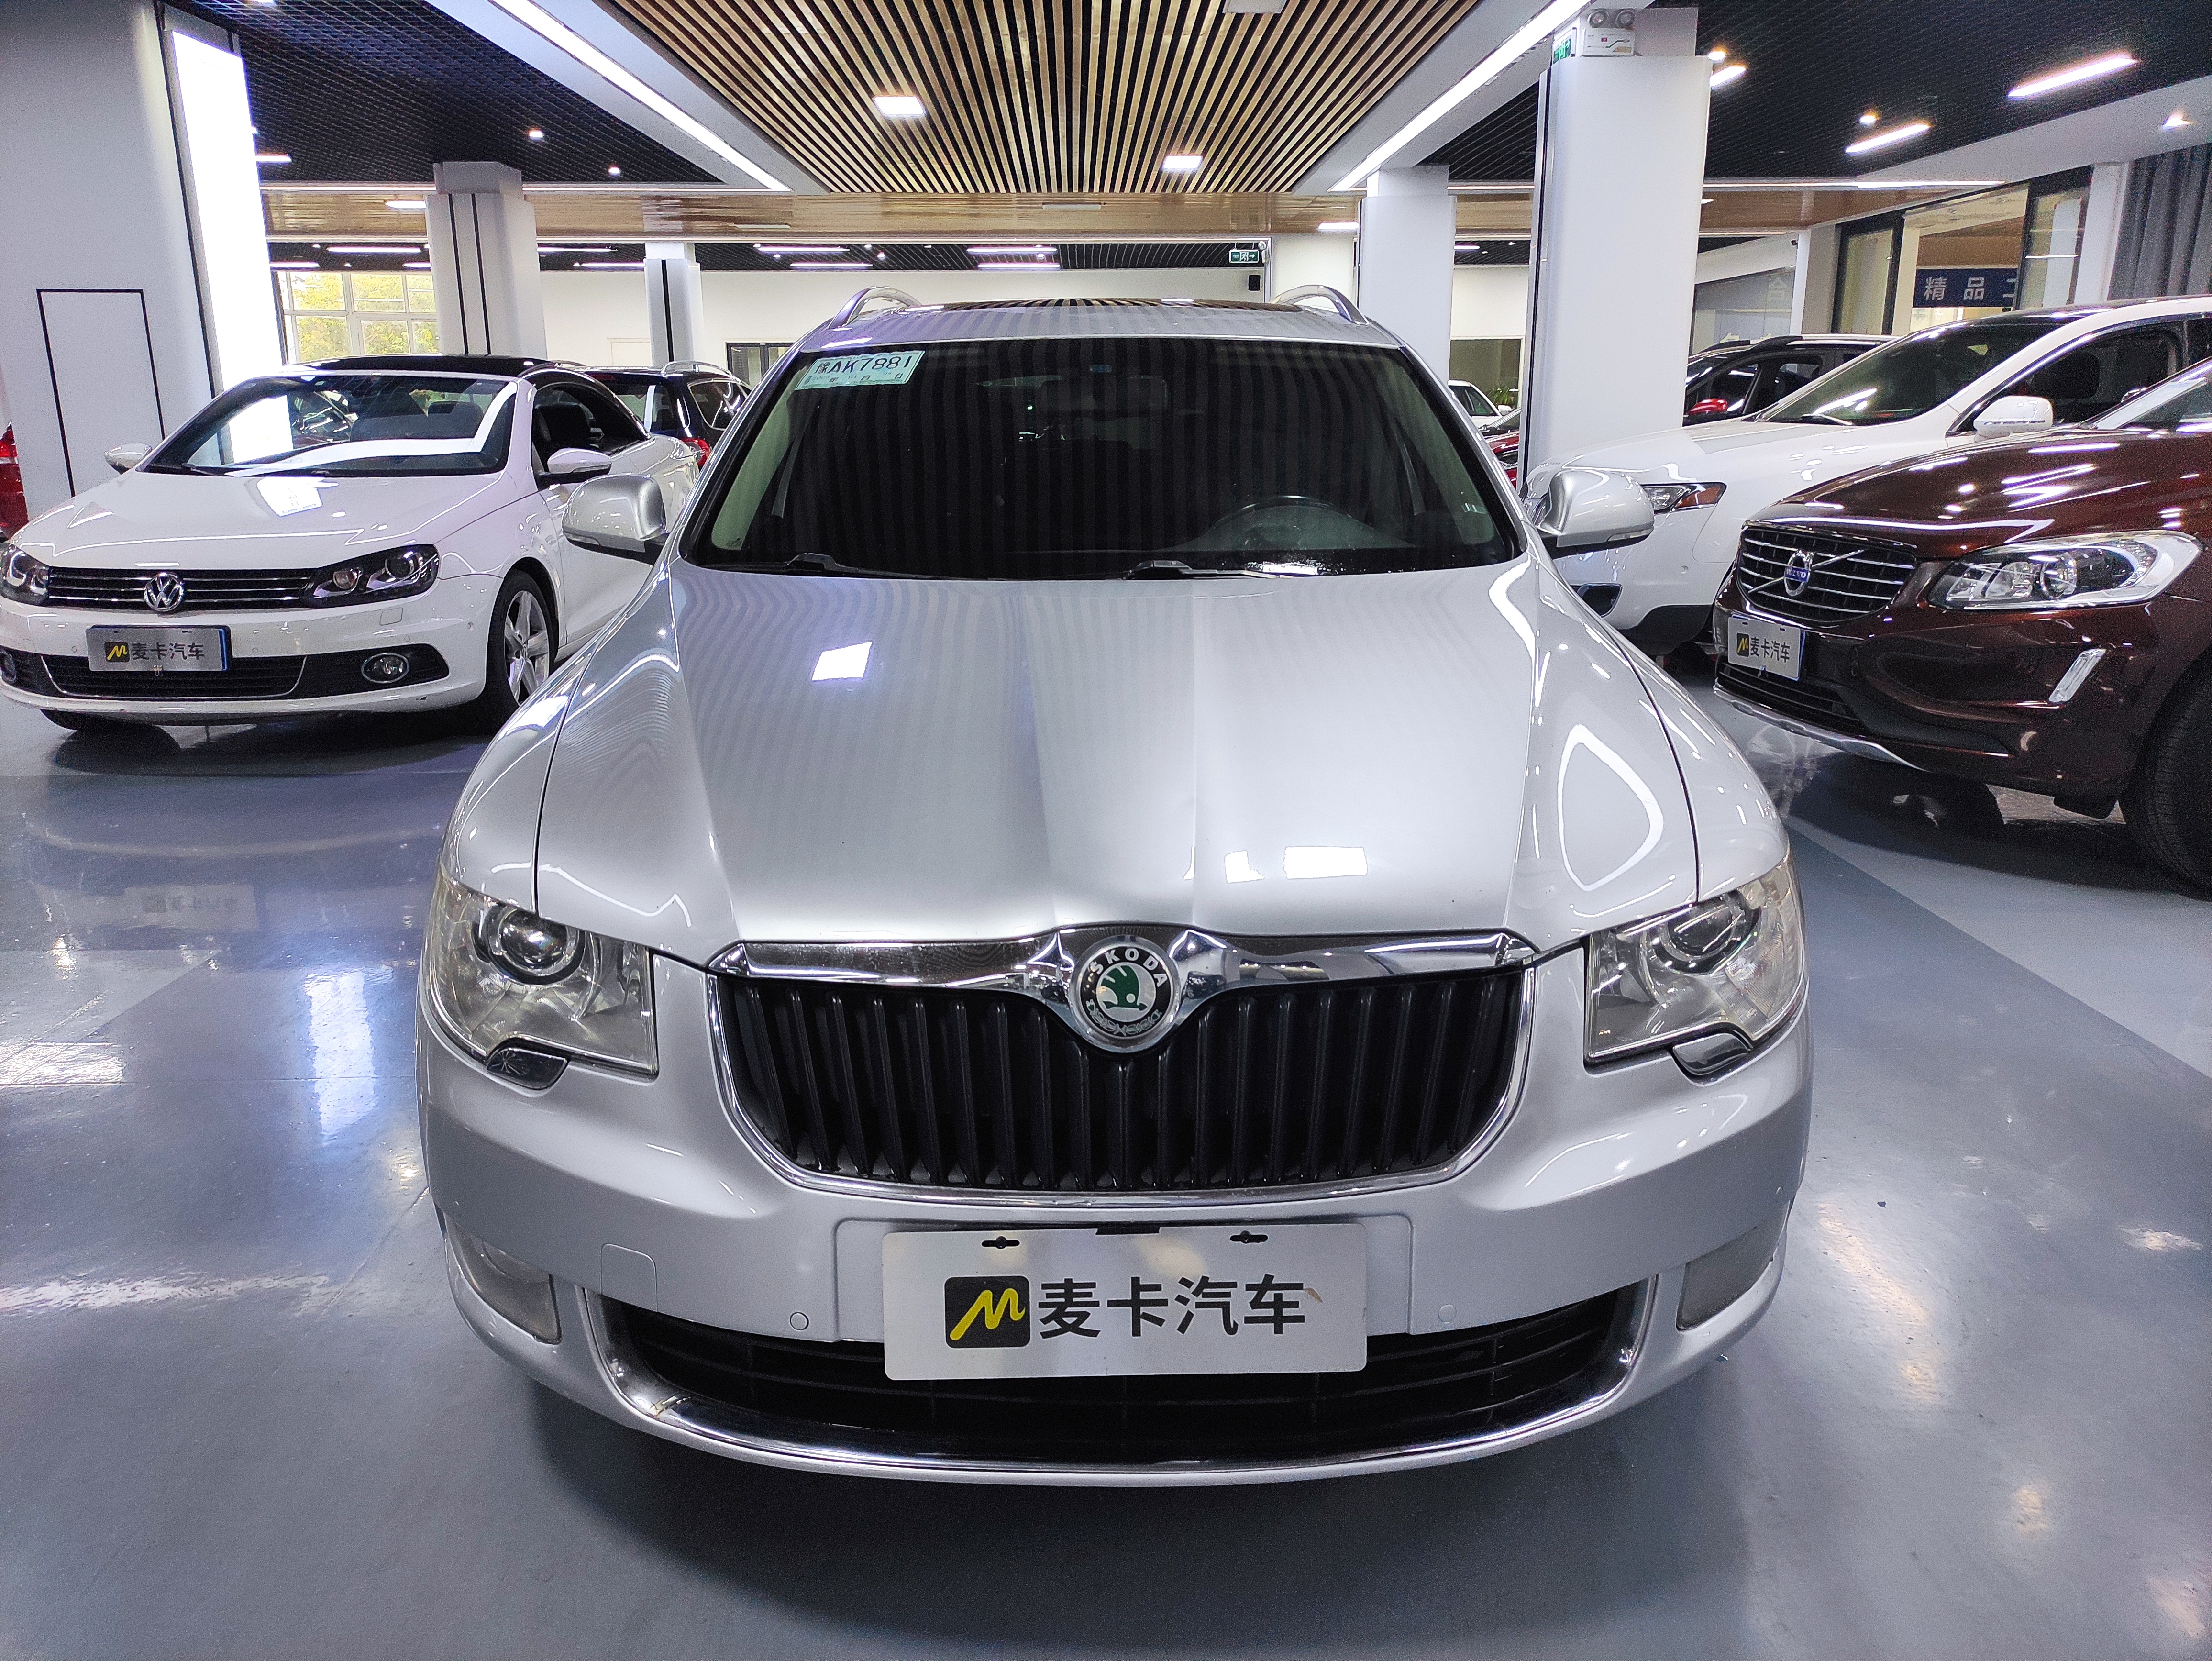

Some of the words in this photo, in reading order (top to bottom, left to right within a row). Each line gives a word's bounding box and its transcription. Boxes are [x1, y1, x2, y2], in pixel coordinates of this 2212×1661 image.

[131, 642, 205, 660] 麦卡汽车
[1750, 636, 1790, 663] 麦卡汽车
[1038, 1273, 1305, 1339] 麦卡汽车
